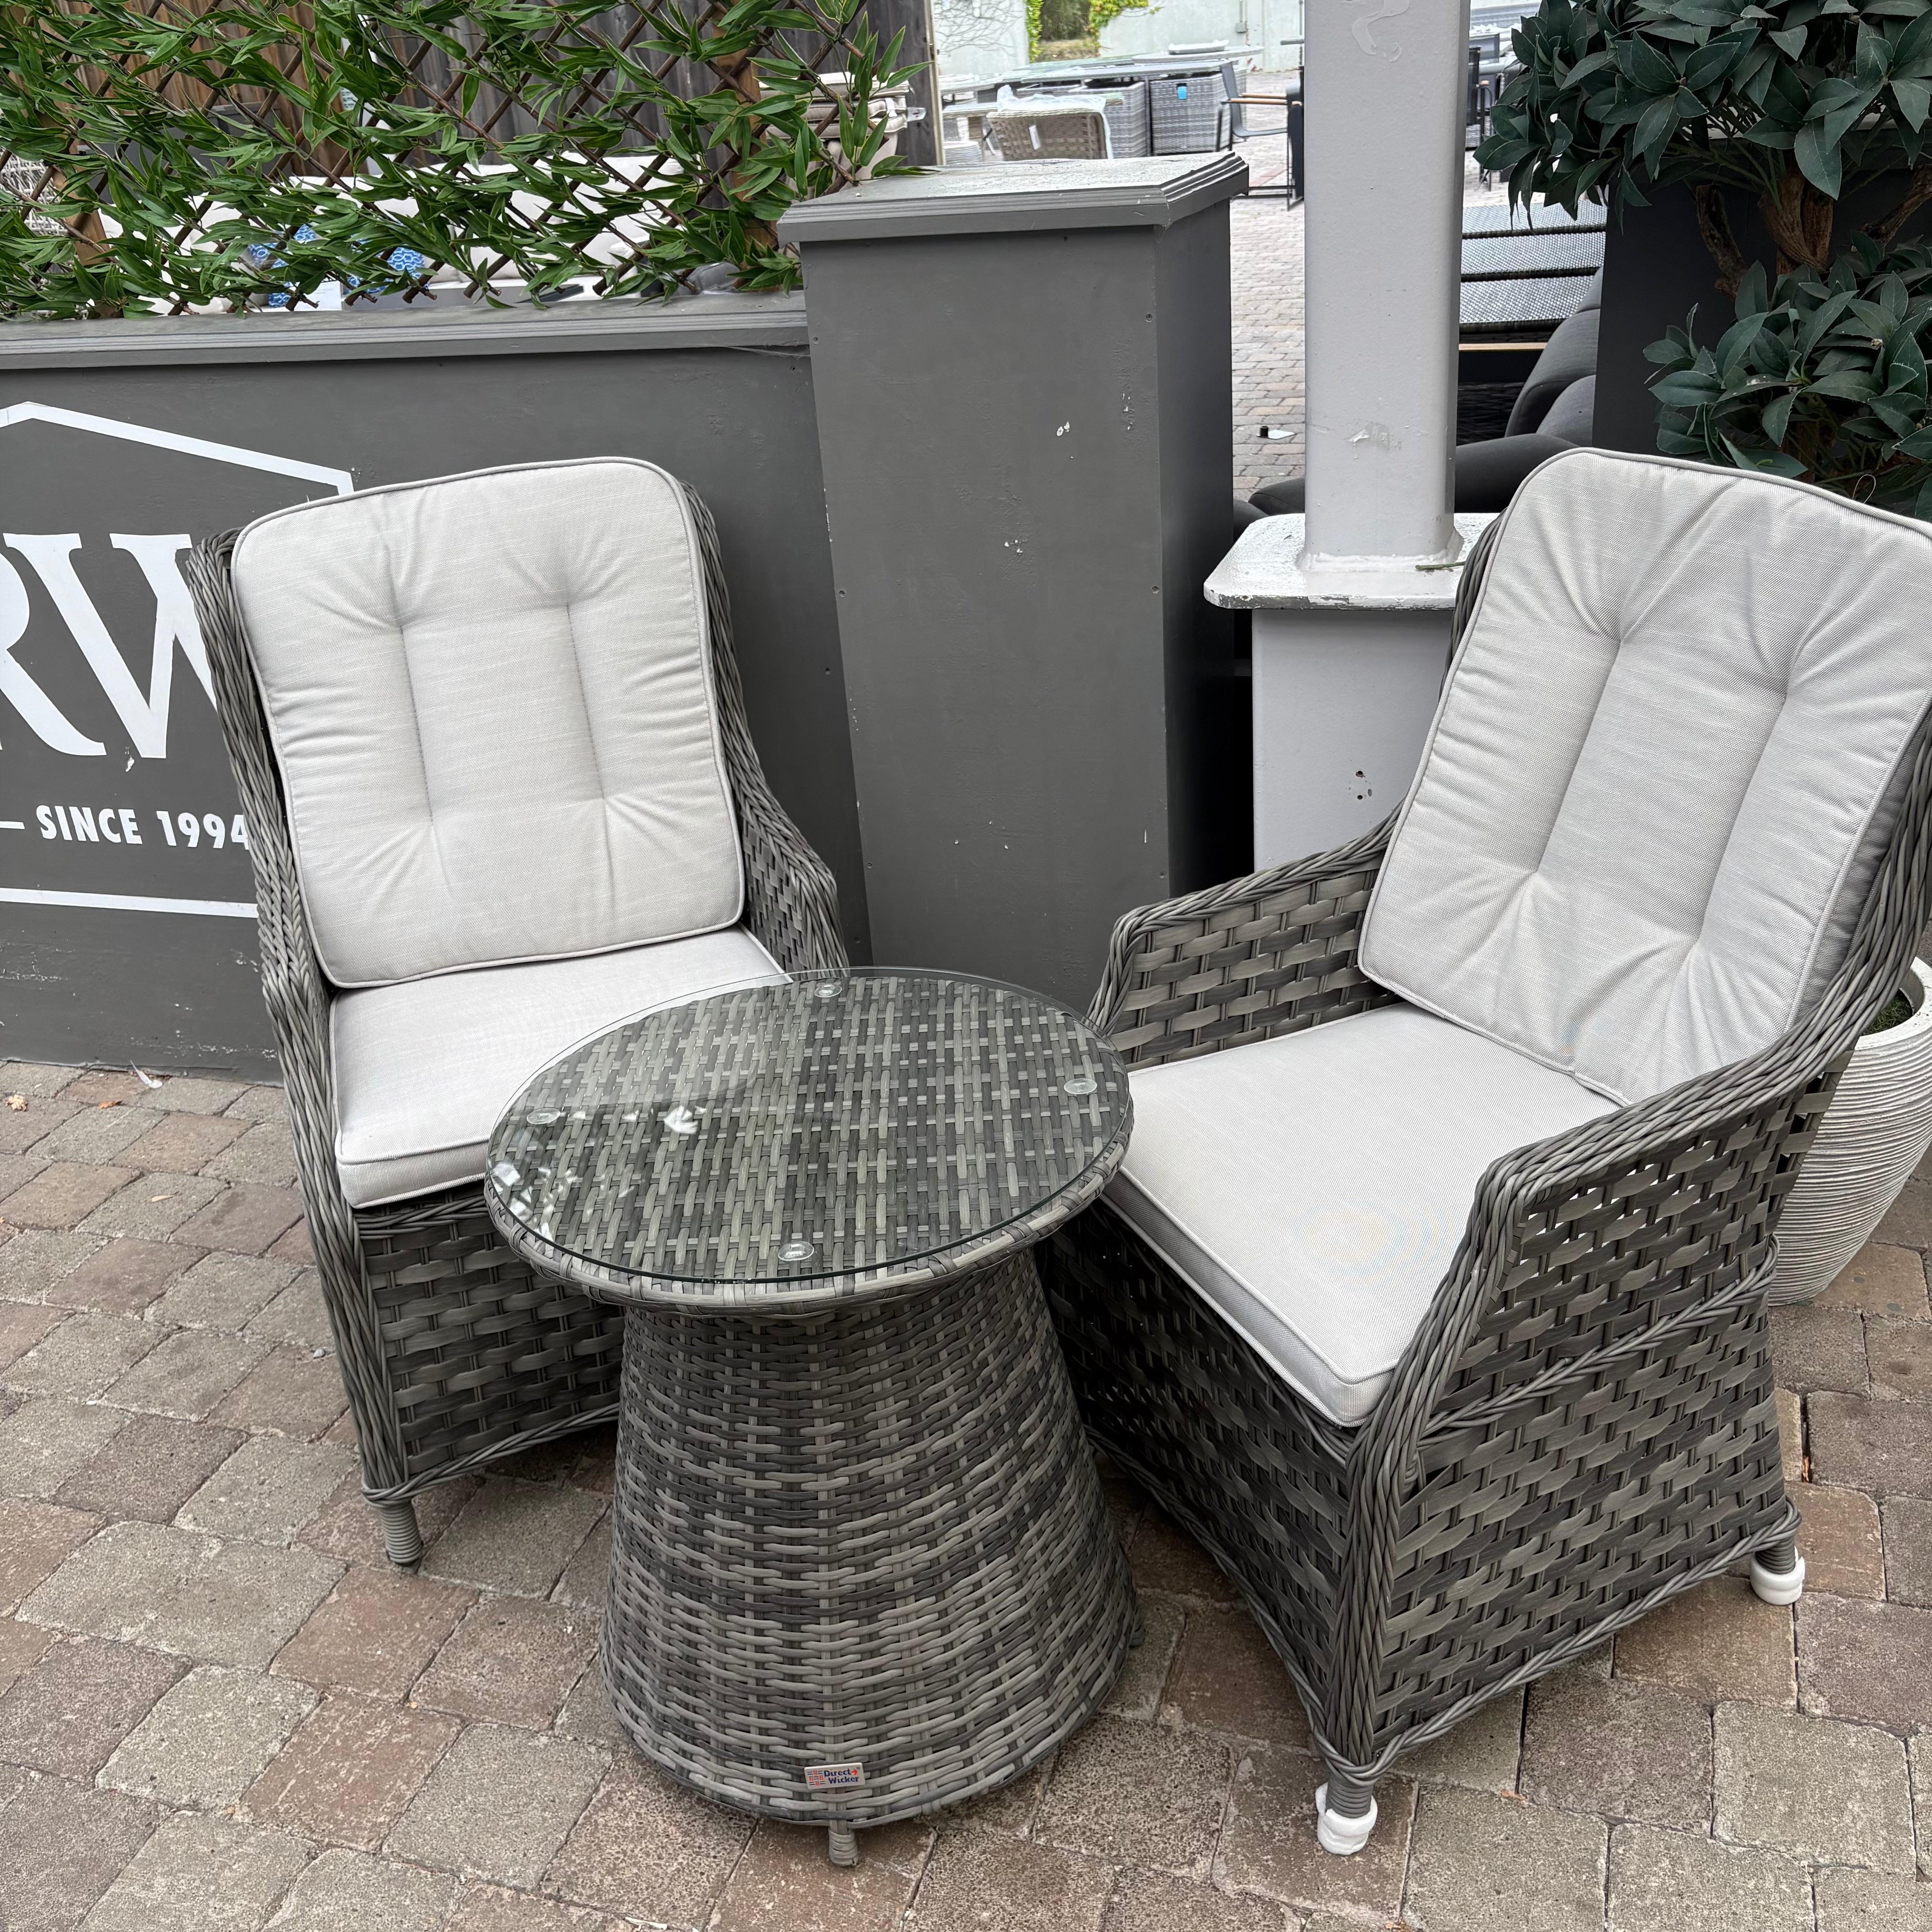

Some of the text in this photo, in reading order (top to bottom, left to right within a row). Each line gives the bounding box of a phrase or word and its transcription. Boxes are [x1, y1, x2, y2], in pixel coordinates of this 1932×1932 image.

[36, 805, 249, 850] SINCE 1994
[824, 1769, 851, 1777] Direct
